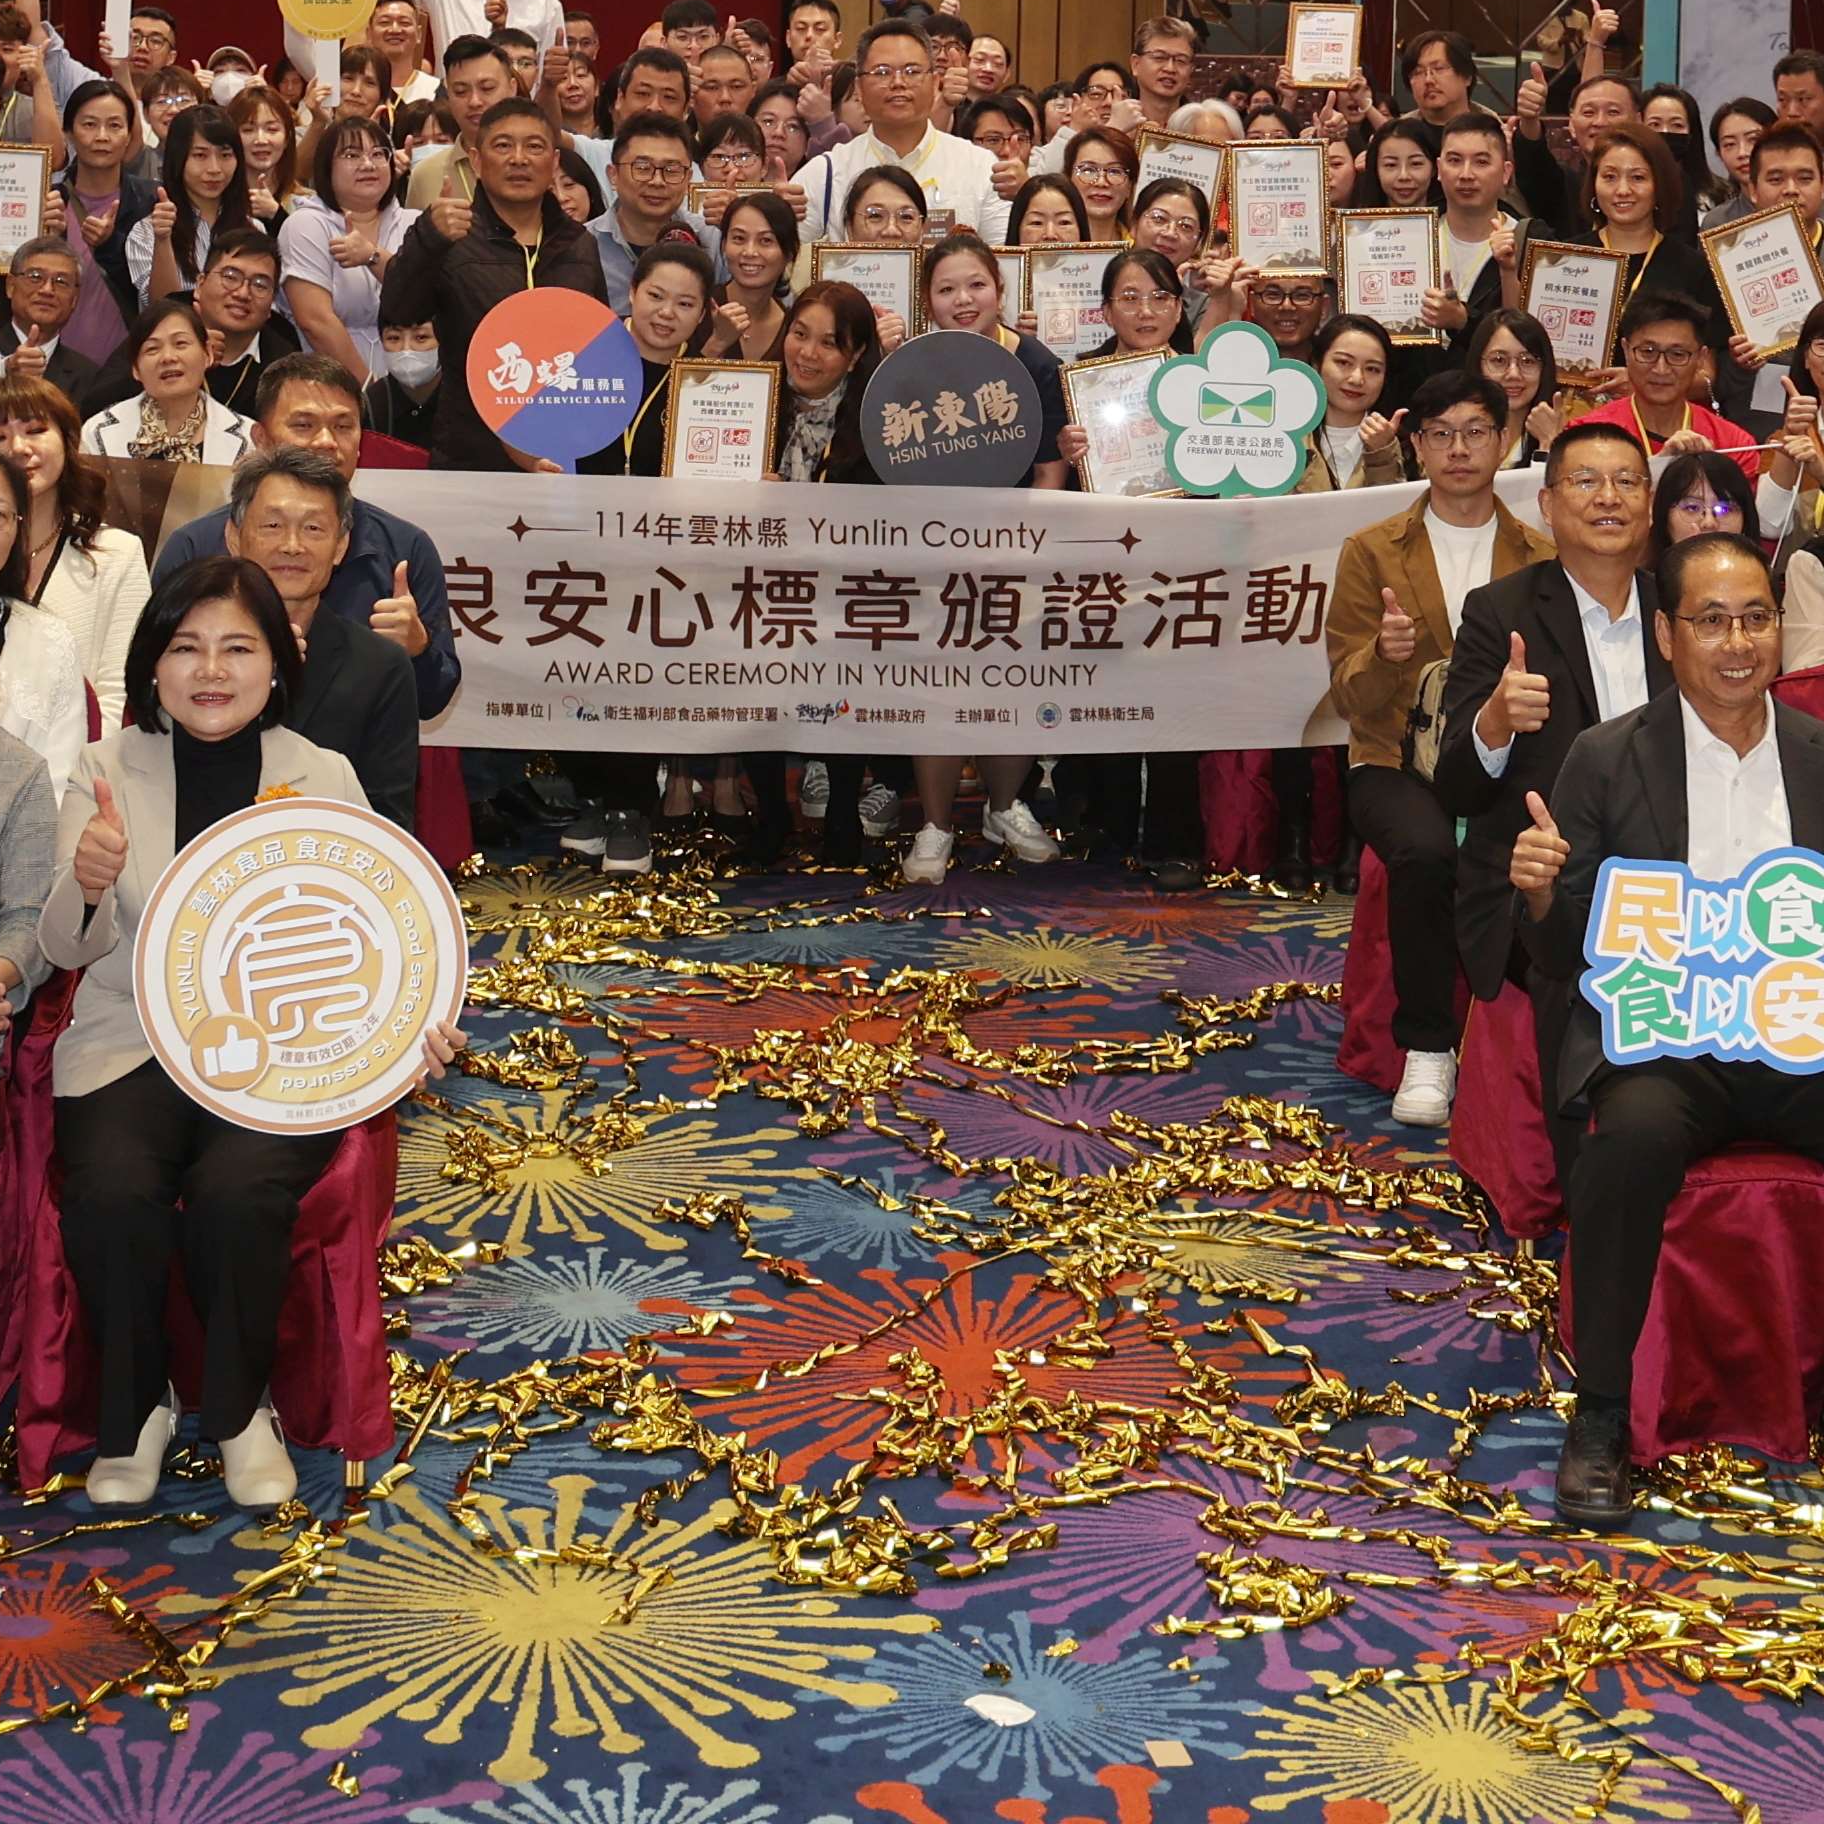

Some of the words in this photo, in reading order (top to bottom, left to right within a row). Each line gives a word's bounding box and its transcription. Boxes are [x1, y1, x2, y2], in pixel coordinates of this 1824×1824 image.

[488, 341, 580, 393] 西螺
[582, 378, 625, 391] 服務區
[496, 396, 534, 405] XILUO
[538, 396, 591, 404] SERVICE
[594, 395, 626, 404] AREA
[881, 379, 1019, 448] 新東陽
[889, 446, 927, 465] HSIN
[932, 434, 978, 456] TUNG
[980, 424, 1026, 446] YANG
[1187, 434, 1285, 449] 交通部高速公路局
[1187, 447, 1223, 456] FREEWAY
[1261, 449, 1284, 458] MOTC
[595, 511, 789, 547] 114年雲林縣
[808, 517, 907, 547] Yunlin
[921, 521, 1047, 554] County
[544, 662, 654, 685] AWARD
[664, 662, 827, 687] CEREMONY
[837, 663, 864, 685] IN
[873, 664, 971, 687] YUNLIN
[981, 663, 1098, 687] COUNTY
[855, 709, 926, 723] 雲林縣政府
[1069, 707, 1155, 722] 雲林縣衛生局
[189, 841, 287, 919] 雲林食品
[295, 835, 397, 892] 食在安心
[395, 898, 426, 956] Food
[177, 930, 200, 1020] YUNLIN
[391, 962, 423, 1037] safety
[280, 1057, 370, 1093] assured
